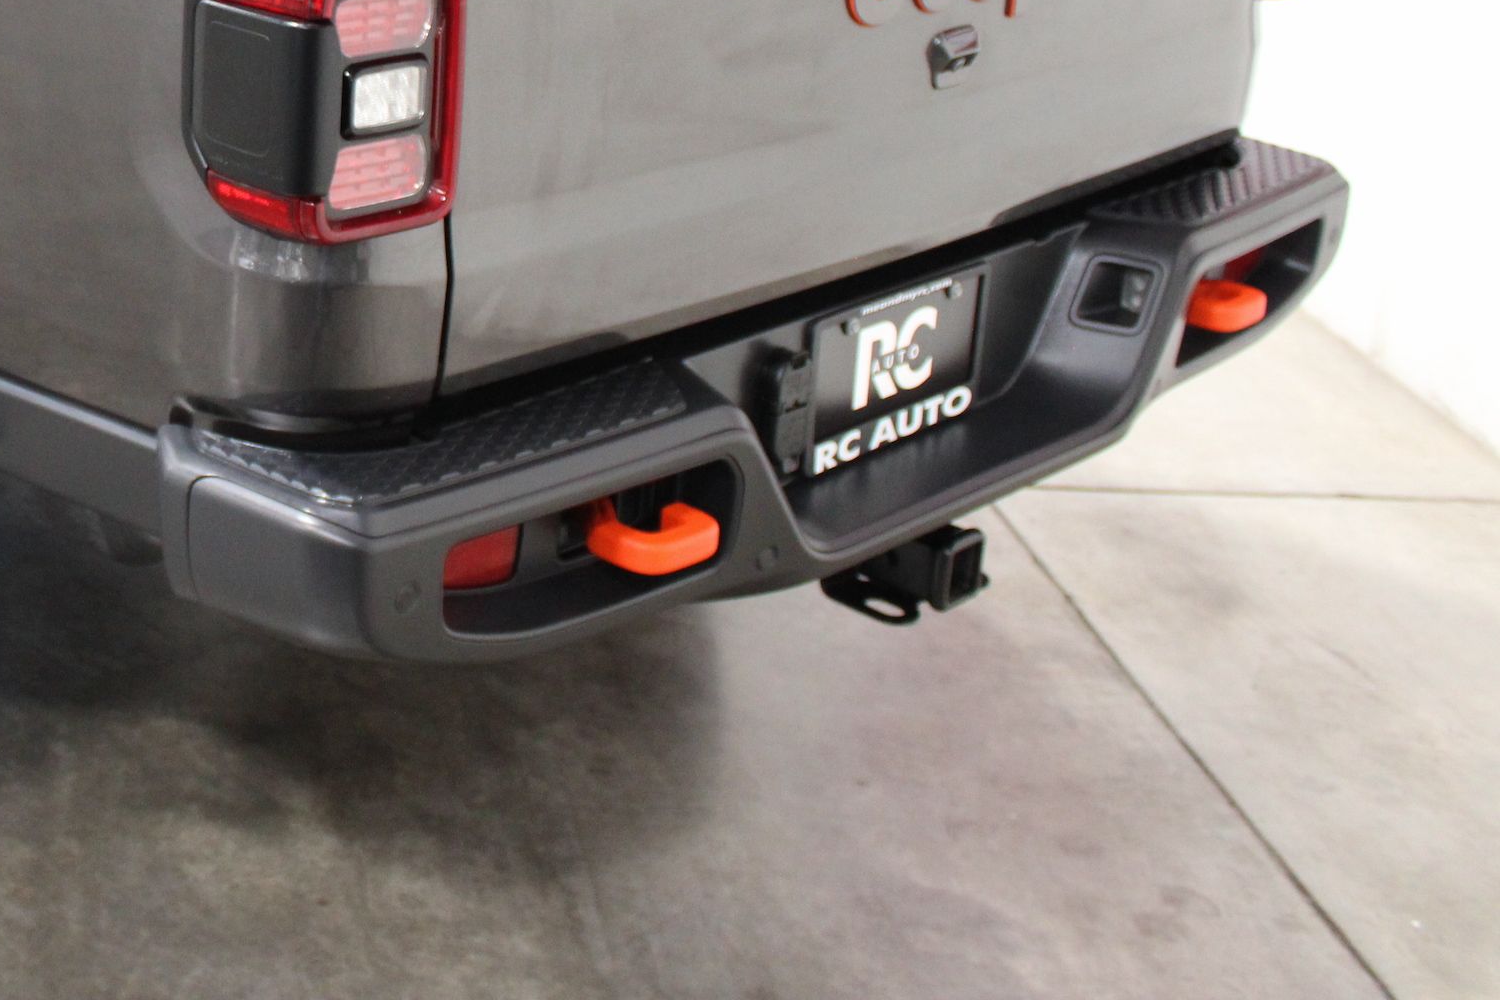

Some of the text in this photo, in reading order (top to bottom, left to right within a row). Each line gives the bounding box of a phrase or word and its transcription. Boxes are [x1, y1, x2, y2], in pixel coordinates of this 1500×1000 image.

[852, 305, 938, 411] RC
[871, 343, 920, 374] AUTO
[813, 385, 973, 476] RC AUTO
